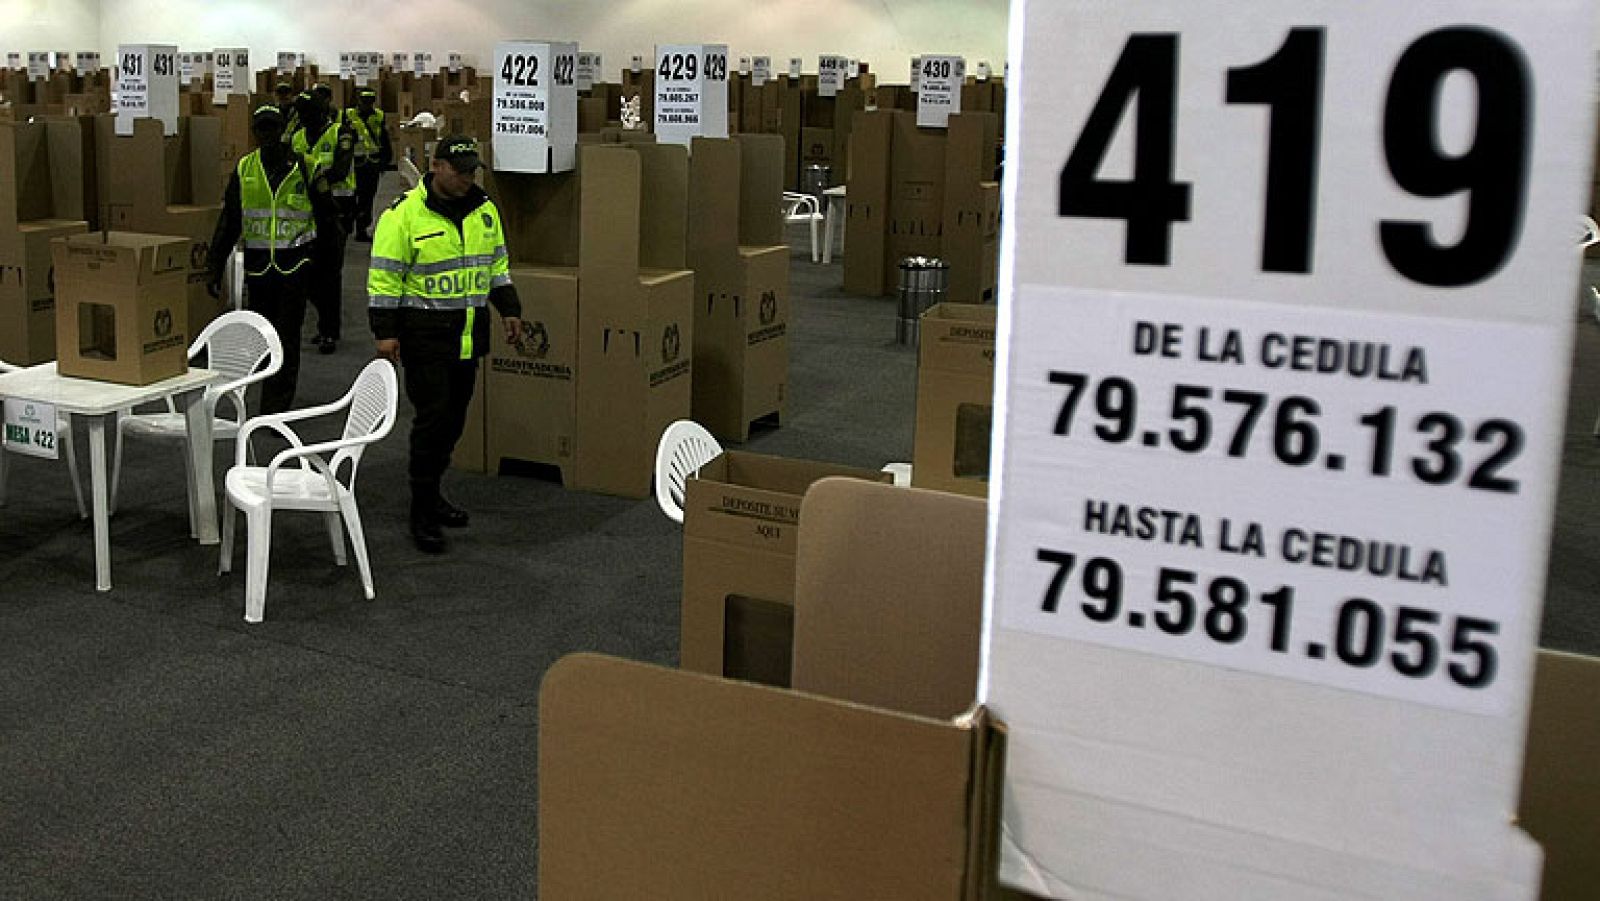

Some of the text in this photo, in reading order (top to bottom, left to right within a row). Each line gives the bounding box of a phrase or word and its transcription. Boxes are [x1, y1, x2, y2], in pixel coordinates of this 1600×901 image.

[122, 53, 142, 75] 431
[153, 53, 174, 75] 431
[501, 53, 538, 86] 422
[553, 53, 574, 86] 422
[658, 53, 697, 80] 429
[703, 53, 726, 81] 429
[922, 60, 951, 78] 430
[1056, 22, 1538, 289] 419
[1133, 320, 1429, 385] DE LA CEDULA
[33, 429, 54, 449] 422
[1046, 370, 1527, 495] 79.576.132
[1083, 499, 1450, 587] HASTA LA CEDULA
[1035, 548, 1501, 690] 79.581.055
